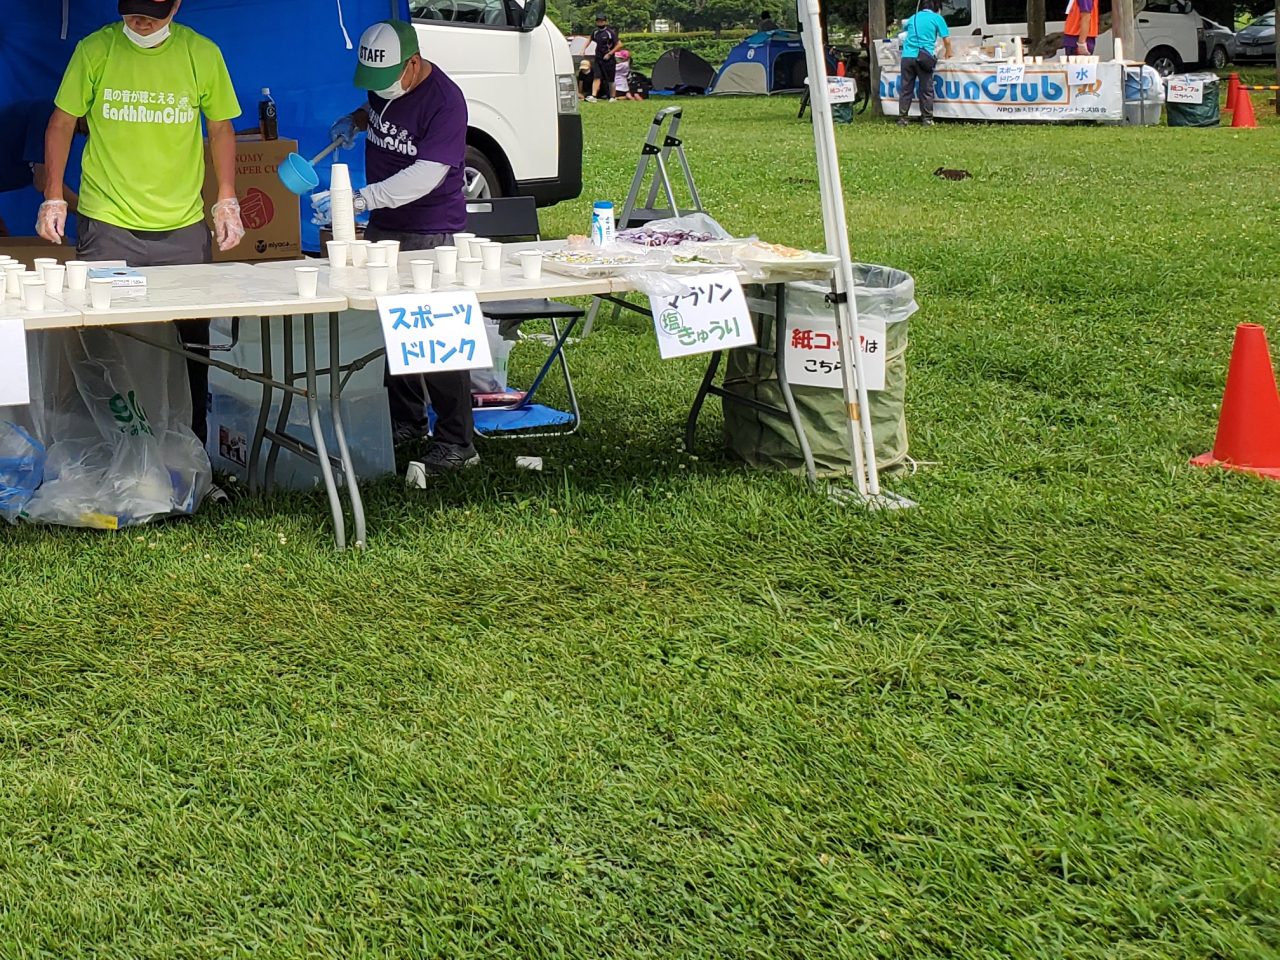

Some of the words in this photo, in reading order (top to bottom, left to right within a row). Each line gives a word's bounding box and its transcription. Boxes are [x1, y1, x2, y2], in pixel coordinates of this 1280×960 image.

[1075, 67, 1089, 81] 水
[102, 102, 195, 124] EarthRunClub
[388, 304, 473, 331] スポーツ
[400, 338, 476, 366] ドリンク
